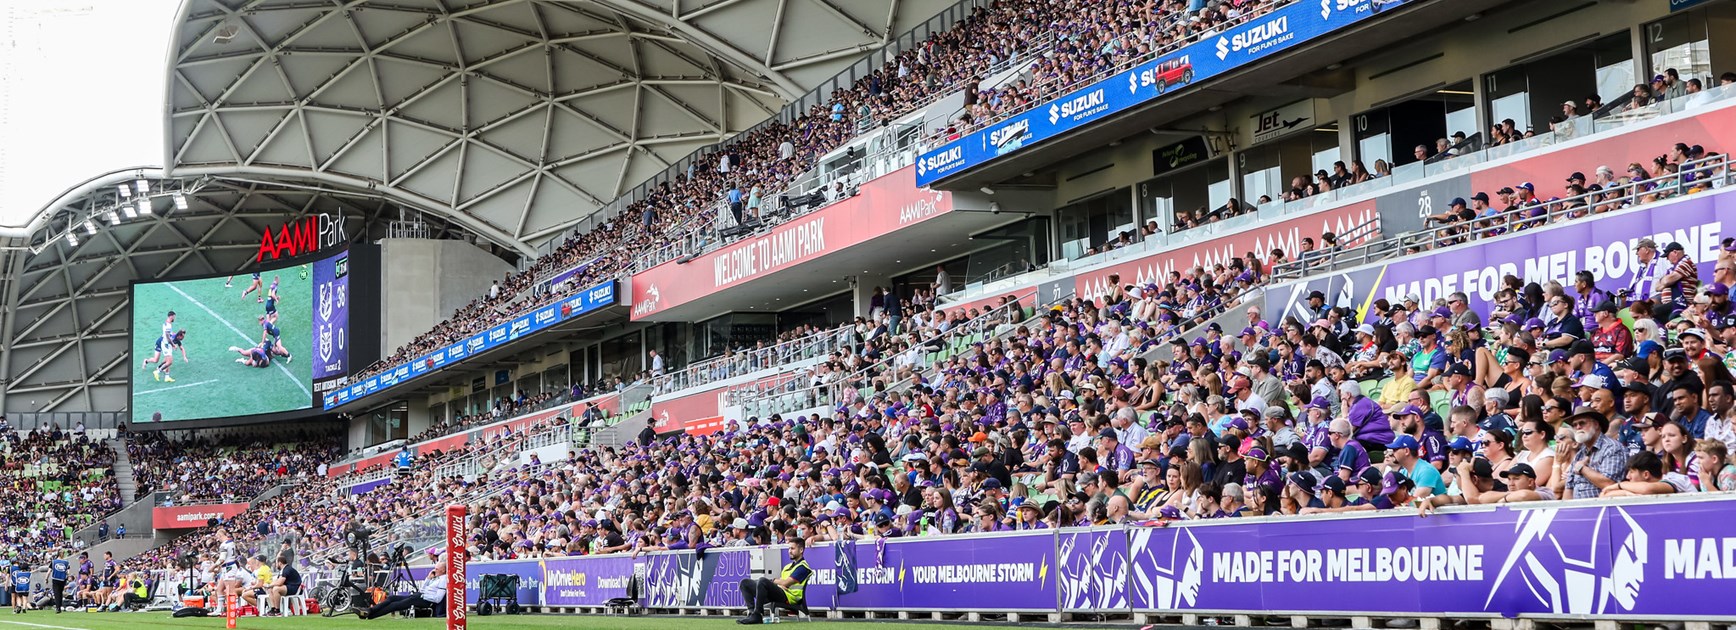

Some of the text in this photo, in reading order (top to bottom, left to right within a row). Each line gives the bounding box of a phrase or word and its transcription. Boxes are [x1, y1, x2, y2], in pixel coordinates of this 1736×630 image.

[1232, 16, 1288, 52] SUZUKI
[1248, 44, 1260, 54] FOR
[1278, 32, 1294, 46] SAKE
[1649, 23, 1664, 44] 12
[1487, 74, 1498, 93] 11
[1062, 88, 1104, 118] SUZUKI
[1074, 113, 1084, 122] FOR
[1096, 104, 1108, 113] SAKE
[1255, 111, 1280, 134] Jet
[1356, 115, 1368, 132] 10
[928, 146, 962, 170] SUZUKI
[1240, 152, 1246, 168] 9
[1142, 183, 1148, 198] 8
[1418, 196, 1432, 218] 28
[256, 206, 346, 262] AAMI Park
[1320, 209, 1371, 248] AAMI
[714, 217, 825, 288] WELCOME TO AAMI PARK
[1254, 226, 1300, 266] AAMI
[1193, 244, 1234, 278] AAMI
[1136, 258, 1174, 289] AAMI
[336, 285, 346, 308] 36
[594, 286, 610, 300] SUZUKI
[1386, 274, 1458, 311] MADE
[338, 328, 344, 350] 0
[452, 515, 464, 548] Grill'd
[452, 552, 465, 584] Grill'd
[912, 563, 1034, 584] YOUR MELBOURNE STORM
[1212, 544, 1484, 582] MADE FOR MELBOURNE
[548, 569, 586, 590] MyDriveHero
[817, 567, 865, 585] MELBNE
[866, 566, 895, 584] STORM
[452, 588, 466, 620] Grill'd
